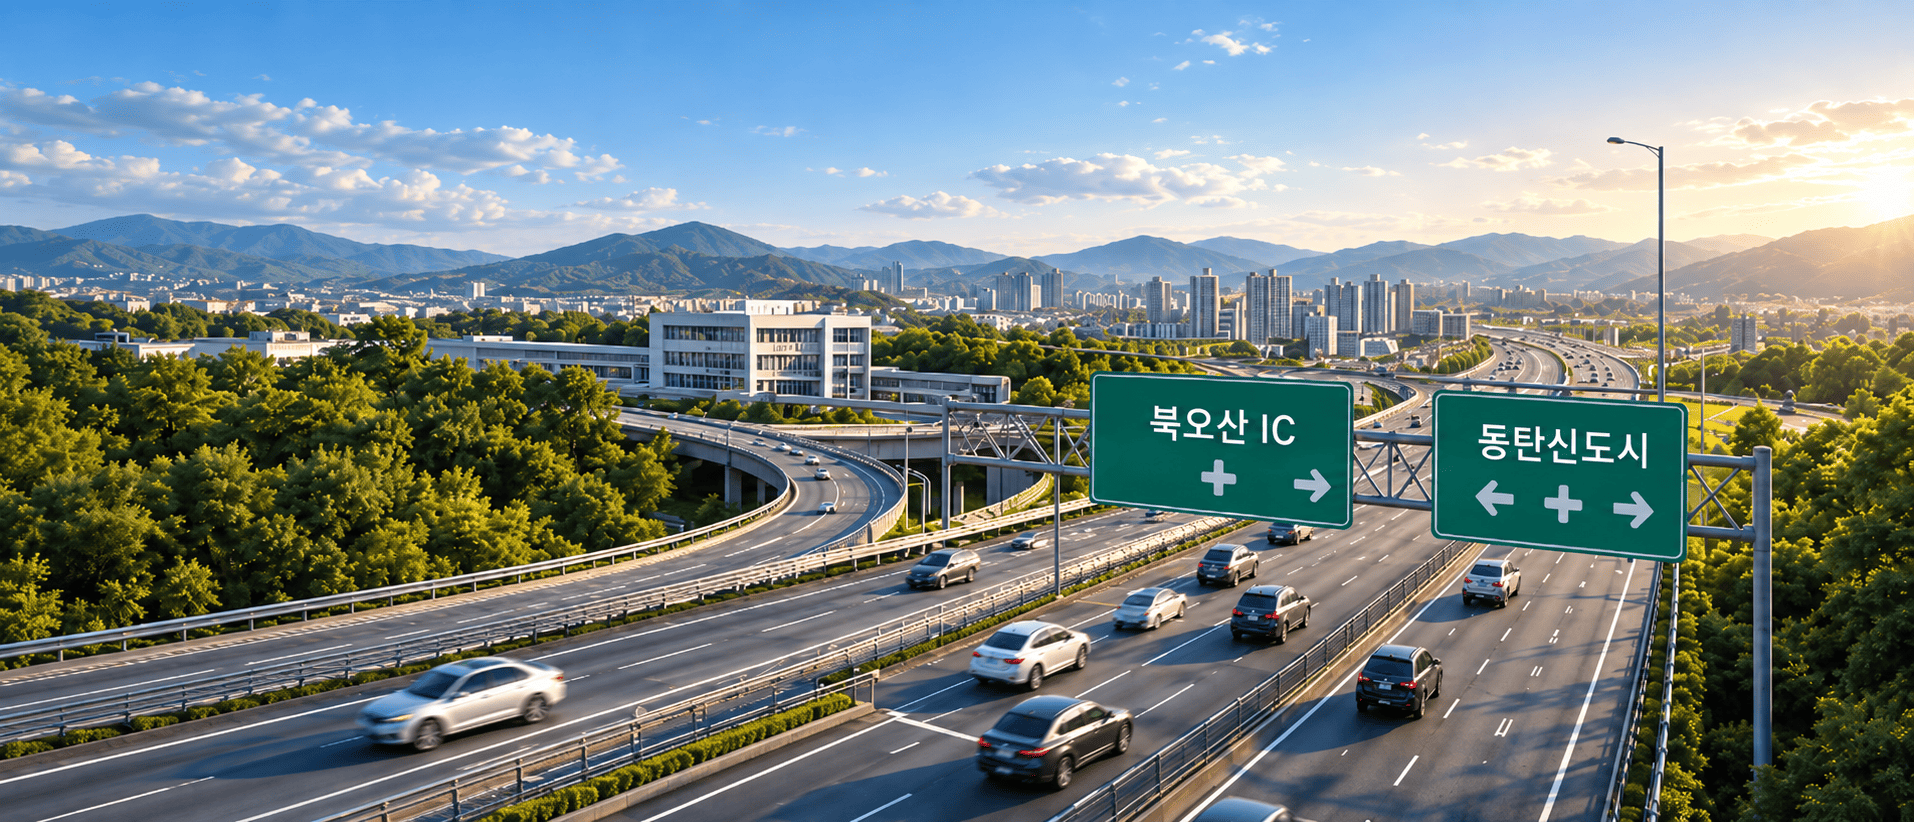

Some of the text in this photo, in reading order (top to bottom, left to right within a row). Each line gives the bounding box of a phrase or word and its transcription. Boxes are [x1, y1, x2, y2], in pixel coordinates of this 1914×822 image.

[1149, 405, 1296, 446] 북오산 IC
[1478, 423, 1648, 469] 동탄신도시
